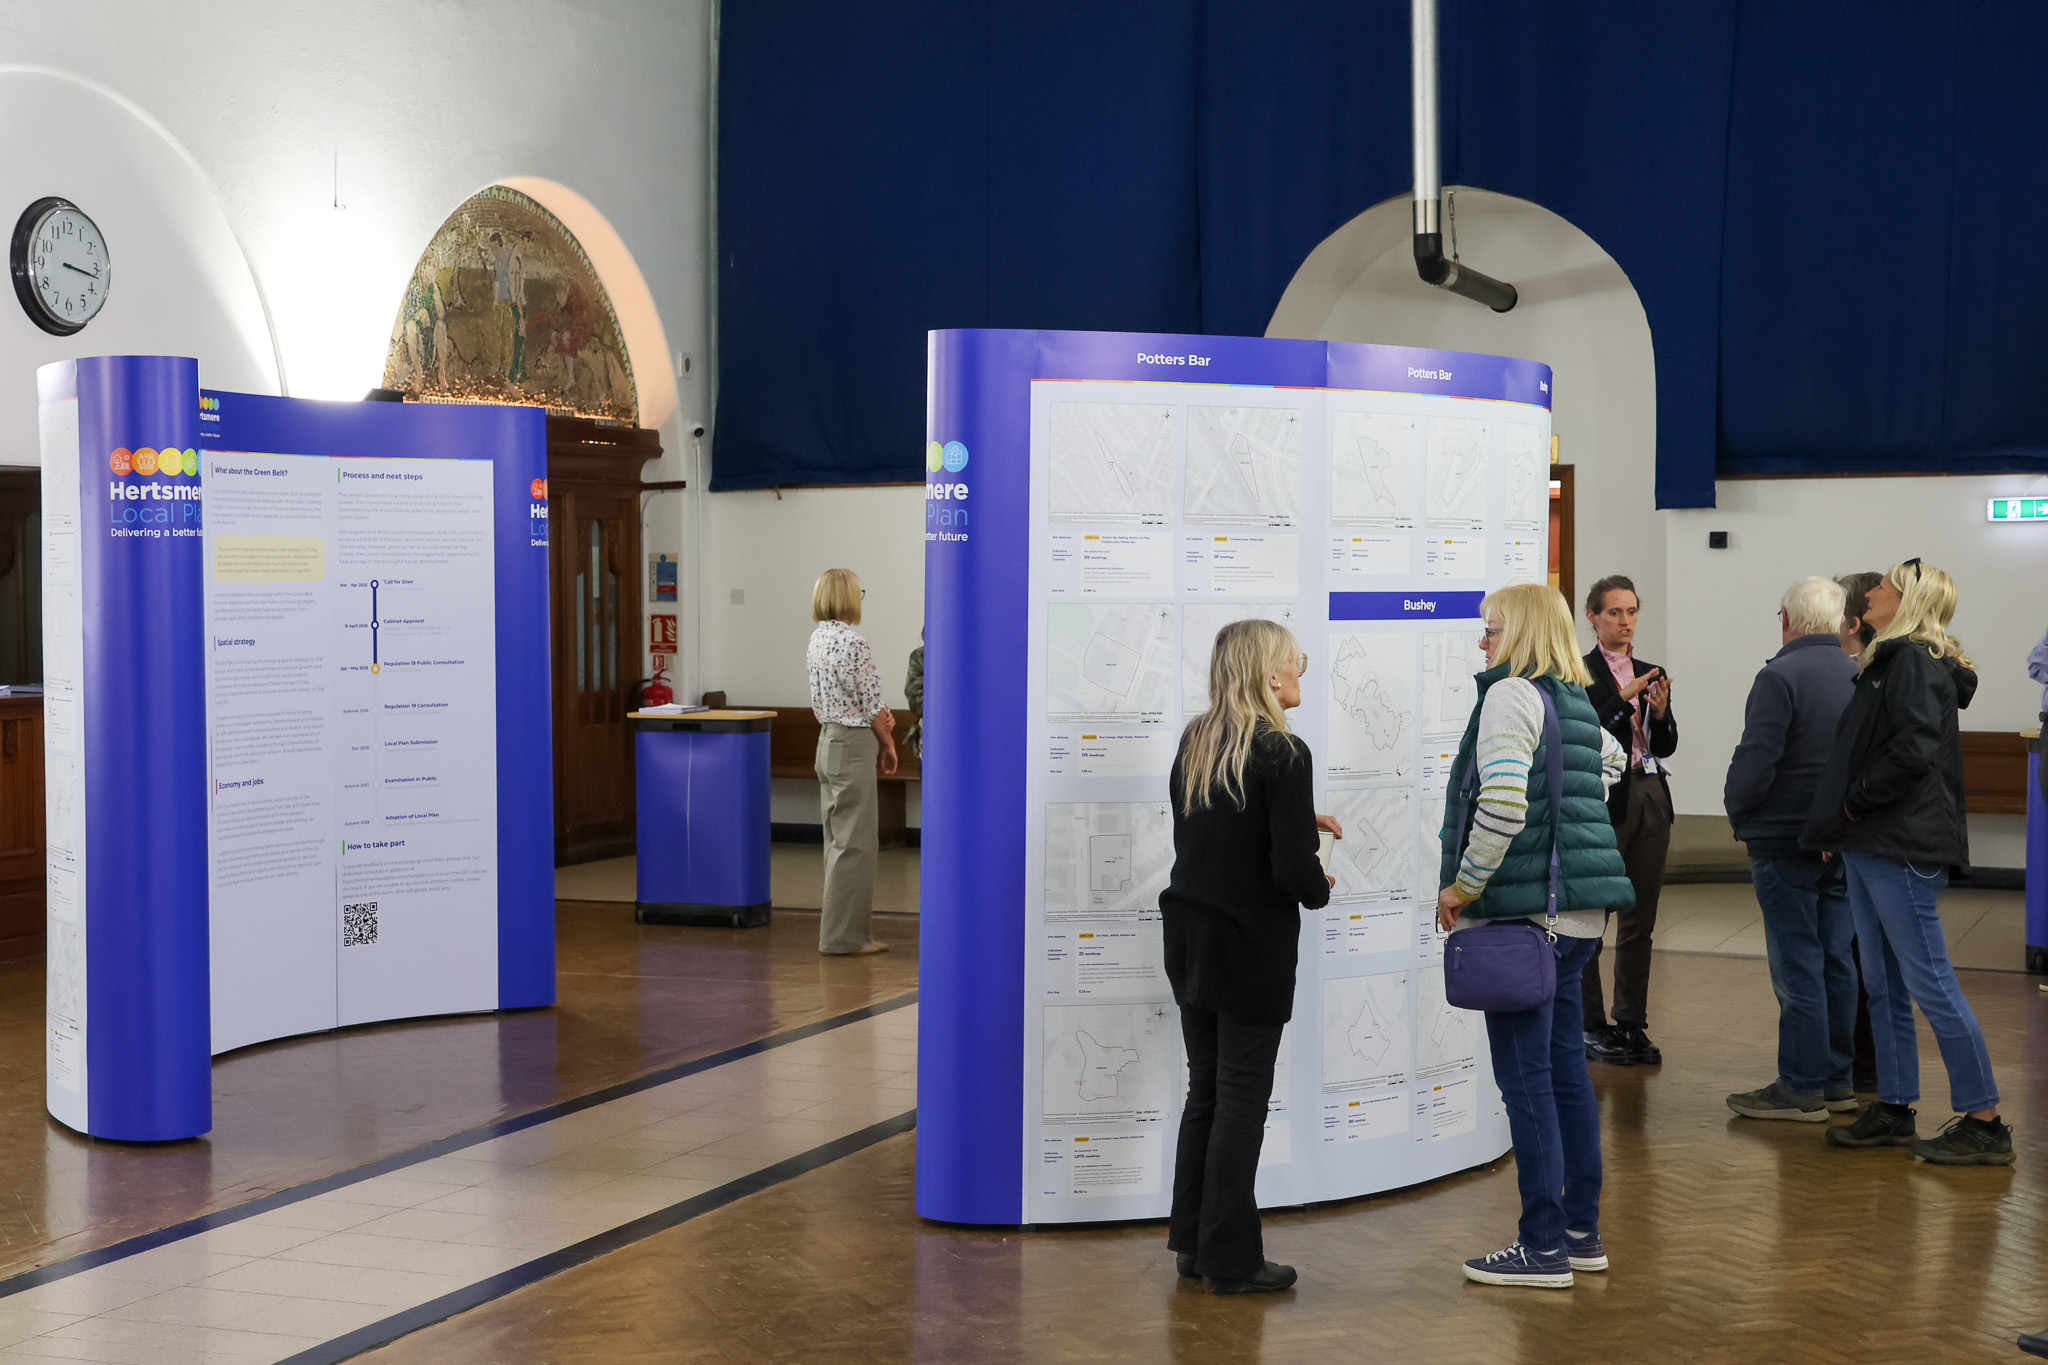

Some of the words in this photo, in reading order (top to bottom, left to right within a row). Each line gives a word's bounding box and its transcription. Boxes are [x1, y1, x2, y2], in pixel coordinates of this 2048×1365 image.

[52, 226, 60, 239] 11
[62, 221, 72, 234] 12
[78, 228, 82, 242] 1
[42, 240, 52, 253] 10
[86, 242, 93, 254] 2
[38, 256, 44, 269] 9
[93, 262, 99, 275] 3
[42, 276, 50, 290] 8
[88, 282, 94, 294] 4
[54, 292, 60, 304] 7
[80, 294, 86, 308] 5
[66, 298, 72, 312] 6
[1136, 352, 1185, 366] Potters
[1188, 354, 1211, 366] Bar
[1408, 367, 1438, 380] Potters
[1439, 370, 1452, 381] Bar
[110, 502, 174, 523] Local
[928, 503, 968, 525] Plan
[110, 528, 160, 538] Delivering
[172, 528, 196, 537] better
[939, 531, 968, 541] future
[1404, 599, 1436, 612] Bushey
[217, 639, 233, 647] Spatial
[234, 638, 255, 646] strategy
[252, 778, 264, 787] jobs
[390, 840, 405, 848] part
